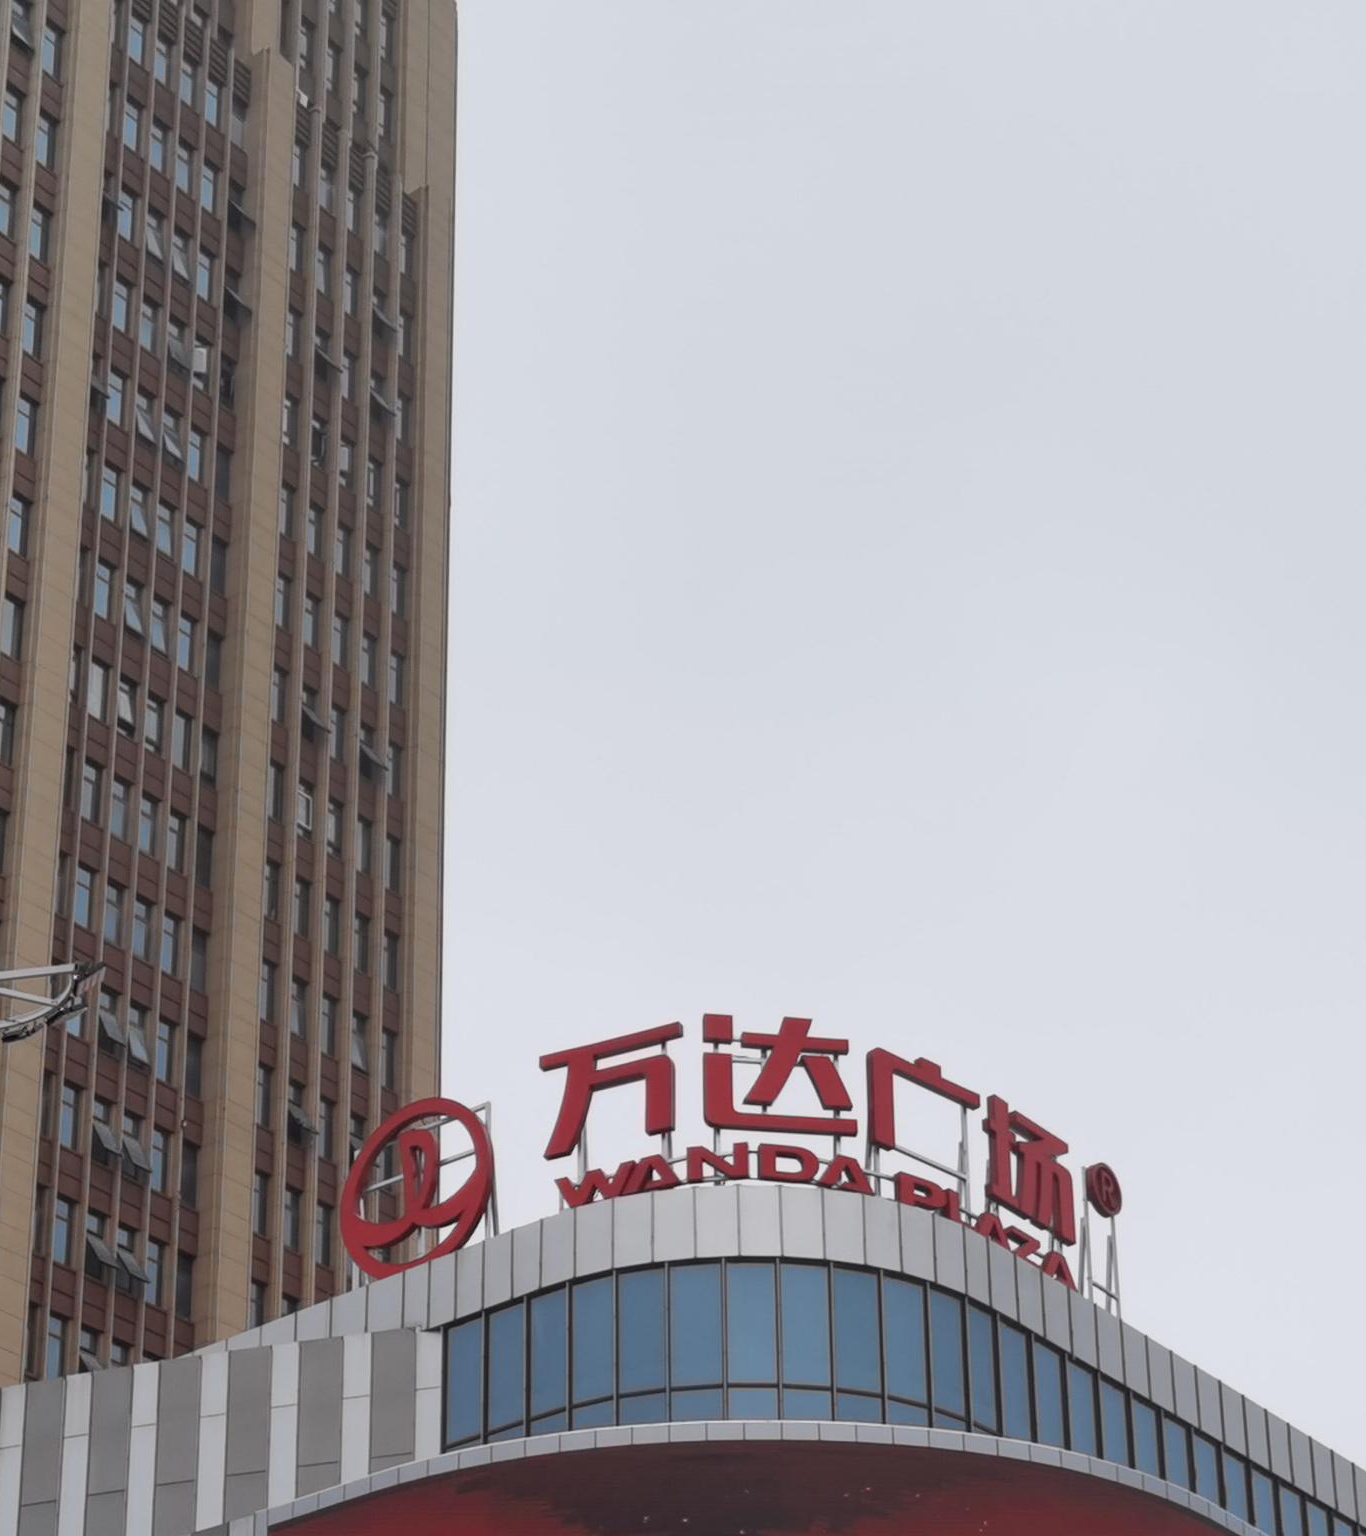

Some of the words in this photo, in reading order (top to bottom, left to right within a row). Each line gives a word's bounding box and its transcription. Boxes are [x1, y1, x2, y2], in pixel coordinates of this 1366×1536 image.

[539, 1013, 1077, 1247] 万达广场
[554, 1142, 875, 1209] WANDA
[893, 1171, 1079, 1292] PLAZA
